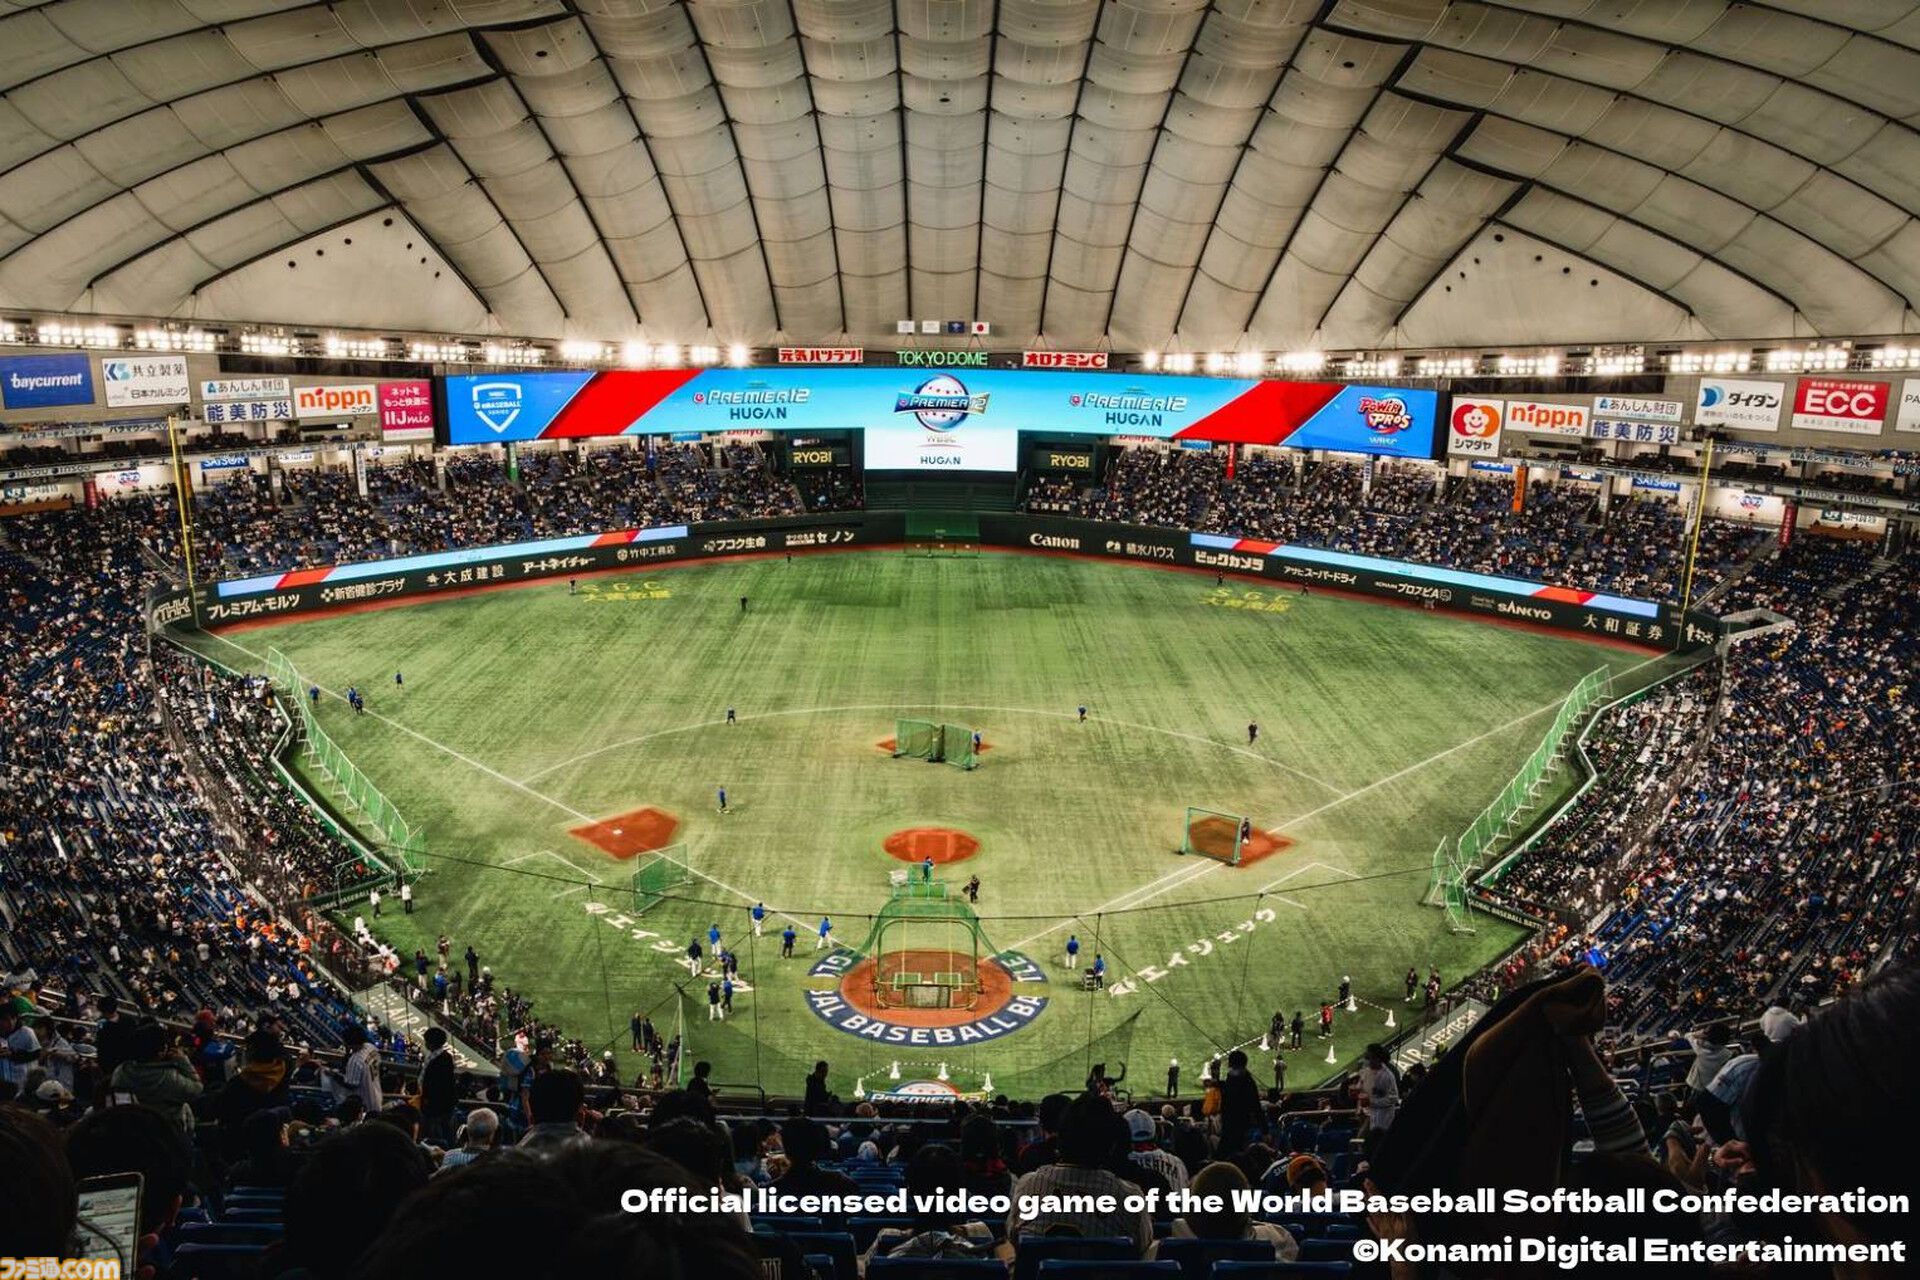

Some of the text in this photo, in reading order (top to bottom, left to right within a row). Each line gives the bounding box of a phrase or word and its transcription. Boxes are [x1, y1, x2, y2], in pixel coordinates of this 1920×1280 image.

[780, 348, 863, 363] 元気ハツラツ!
[896, 351, 989, 367] TOKYO DOME
[1024, 353, 1106, 368] オロナミンC
[10, 373, 82, 391] baycurrent
[219, 381, 285, 393] あんしん財団
[130, 386, 188, 400] 日本カルミック
[300, 388, 371, 410] nippn
[1728, 391, 1780, 409] ダイダン
[207, 402, 291, 421] 能美防災
[1609, 399, 1677, 415] あんしん財団
[1804, 388, 1877, 417] ECC
[384, 410, 431, 425] IIJmio
[1511, 403, 1583, 429] nippn
[1593, 420, 1676, 443] 能美防災
[1453, 438, 1493, 451] シマダヤ
[792, 451, 833, 464] RYOBI
[1050, 453, 1091, 469] RYOBI
[716, 536, 766, 551] フコク生命
[816, 531, 855, 544] セノン
[1028, 533, 1081, 550] Canon
[1126, 542, 1175, 560] 積水ハウス
[522, 556, 596, 574] アートネイチャー
[1194, 550, 1265, 572] ビックカメラ
[443, 564, 505, 584] 大成建設
[157, 596, 191, 621] THK
[1497, 600, 1552, 621] SANKYO
[1583, 612, 1664, 641] 大和証券
[840, 1013, 1019, 1045] BASEBALL
